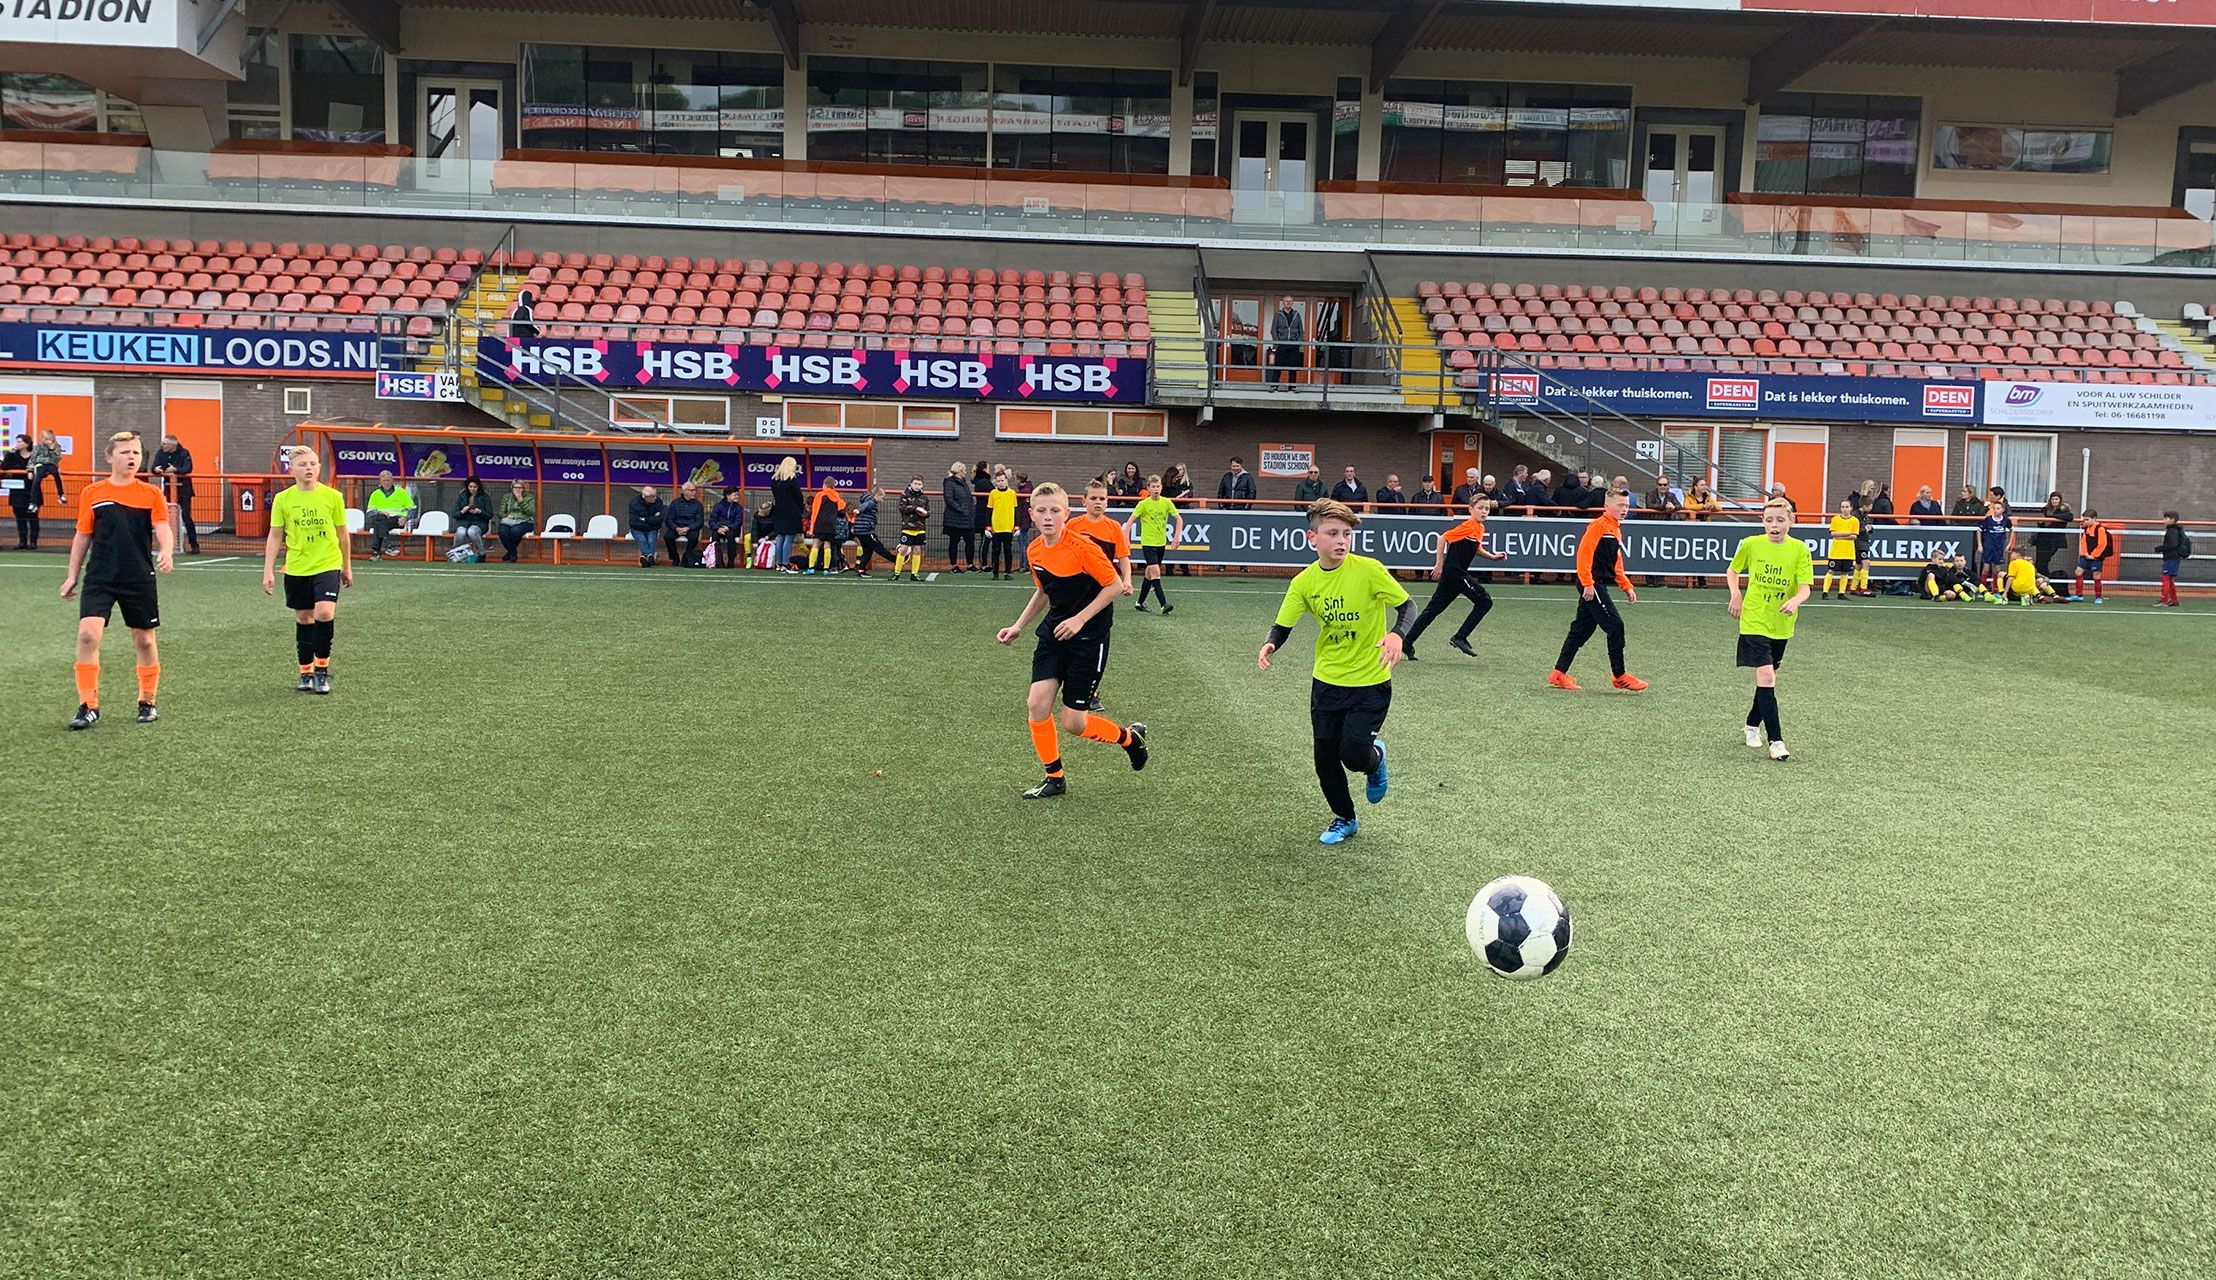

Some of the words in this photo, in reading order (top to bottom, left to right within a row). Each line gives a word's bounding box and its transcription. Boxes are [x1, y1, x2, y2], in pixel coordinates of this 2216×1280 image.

[0, 0, 152, 23] TADION
[511, 346, 602, 375] HSB
[643, 350, 734, 380] HSB
[773, 354, 861, 384] HSB
[900, 358, 988, 389] HSB
[1025, 362, 1111, 393] HSB
[384, 378, 430, 394] HSB
[1712, 384, 1754, 397] DEEN
[1545, 386, 1566, 397] Dat
[1582, 386, 1619, 398] lekker
[1622, 388, 1693, 401] thuiskomen.
[1764, 391, 1786, 402] Dat
[1788, 391, 1798, 402] is
[1801, 391, 1837, 404] lekker
[1840, 392, 1910, 406] thuiskomen.
[1928, 390, 1969, 404] DEEN
[2009, 387, 2036, 400] bm
[2076, 390, 2103, 398] VOOR
[2119, 391, 2136, 399] UW
[2067, 400, 2080, 408] EN
[2082, 401, 2194, 411] SPUITWERKZAAMHEDEN
[338, 450, 397, 462] OSONYQ
[475, 455, 534, 467] OSONYQ
[543, 457, 601, 467] www.osonyq.com
[1271, 452, 1291, 461] HOUDEN
[1291, 453, 1299, 461] WE
[1299, 453, 1310, 461] ONS
[612, 459, 670, 471] OSONYQ
[747, 463, 804, 474] OSOQ
[1263, 461, 1287, 470] STADION
[1287, 462, 1310, 471] SCHOON
[302, 508, 317, 518] Sint
[1232, 527, 1262, 550] DE
[1270, 528, 1375, 553] MOTE
[1868, 539, 1961, 560] KLERKX
[1764, 564, 1783, 575] Sint
[1755, 573, 1791, 587] Nicolaas
[1324, 595, 1345, 611] Sint
